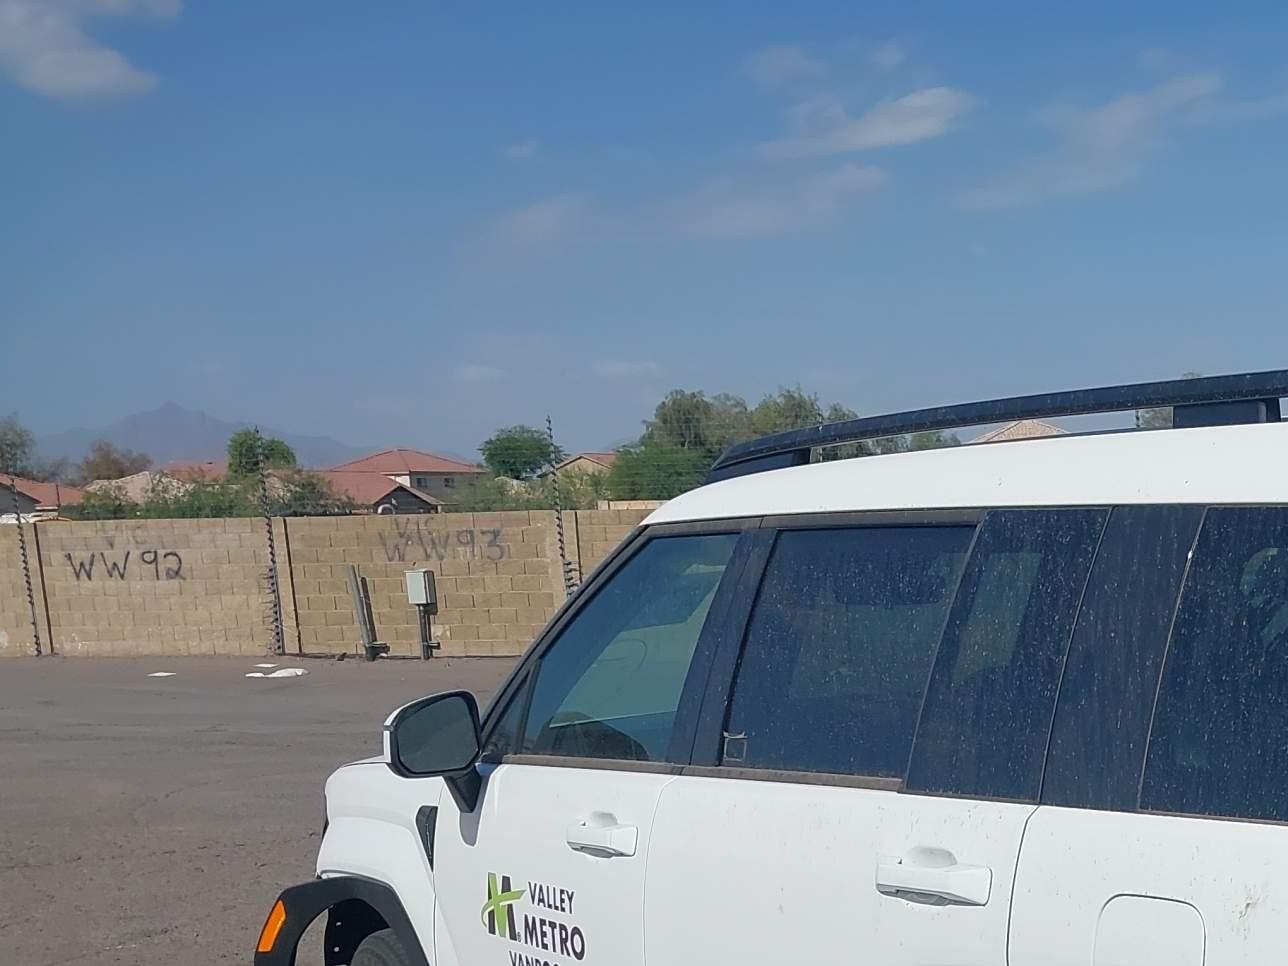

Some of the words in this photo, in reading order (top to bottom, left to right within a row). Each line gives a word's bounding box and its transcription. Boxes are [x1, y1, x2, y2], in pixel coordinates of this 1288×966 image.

[456, 528, 505, 560] 93
[140, 549, 187, 581] 92
[528, 881, 575, 914] VALLEY
[524, 915, 585, 960] METRO
